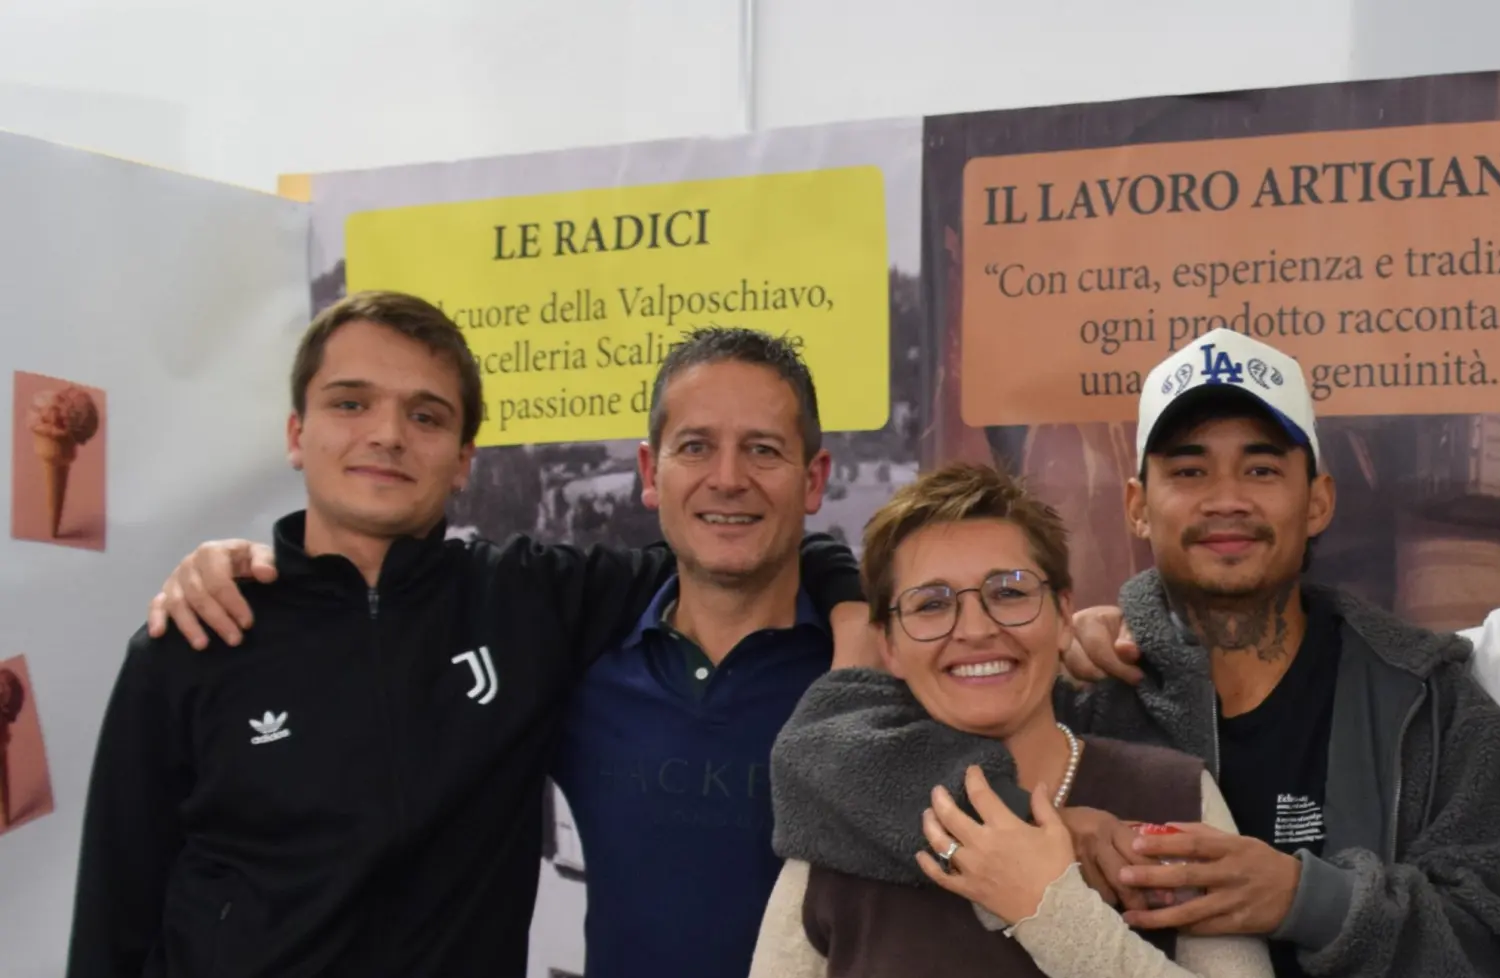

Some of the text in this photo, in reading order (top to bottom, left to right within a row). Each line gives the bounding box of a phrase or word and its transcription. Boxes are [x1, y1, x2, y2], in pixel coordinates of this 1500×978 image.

[983, 186, 1027, 226] IL
[1038, 169, 1239, 223] LAVORO
[493, 208, 711, 262] LE RADICI
[984, 262, 1068, 300] “Con
[1077, 256, 1162, 296] cura,
[1172, 247, 1364, 300] esperienza
[1375, 250, 1394, 279] e
[540, 288, 608, 325] della
[617, 278, 835, 326] Valposchiavo,
[1080, 308, 1157, 356] ogni
[1337, 298, 1500, 336] racconta
[1080, 350, 1499, 402] una genuinità.
[1200, 343, 1244, 384] LA
[500, 387, 623, 432] passione
